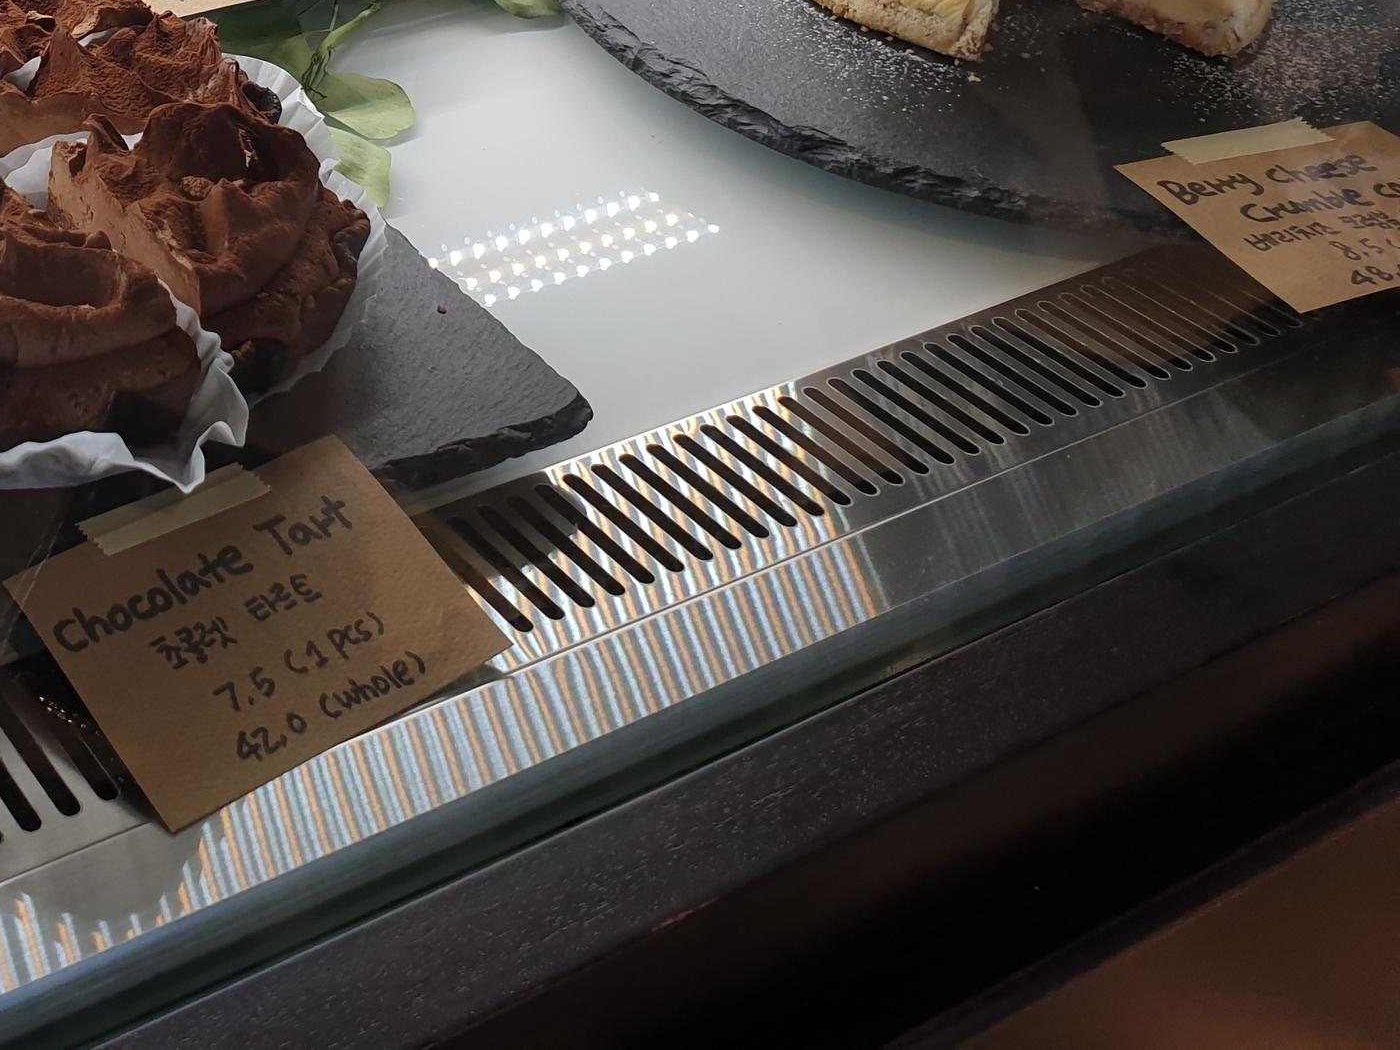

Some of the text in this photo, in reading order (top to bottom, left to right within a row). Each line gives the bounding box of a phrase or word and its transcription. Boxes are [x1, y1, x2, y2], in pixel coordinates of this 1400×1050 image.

[1156, 172, 1265, 206] Berry
[1240, 187, 1376, 223] Crumble
[1328, 237, 1385, 262] 8.5
[52, 494, 354, 654] Chocolate Tart
[243, 572, 323, 623] 타르트
[212, 666, 278, 714] 7.5
[319, 650, 428, 719] (whole)
